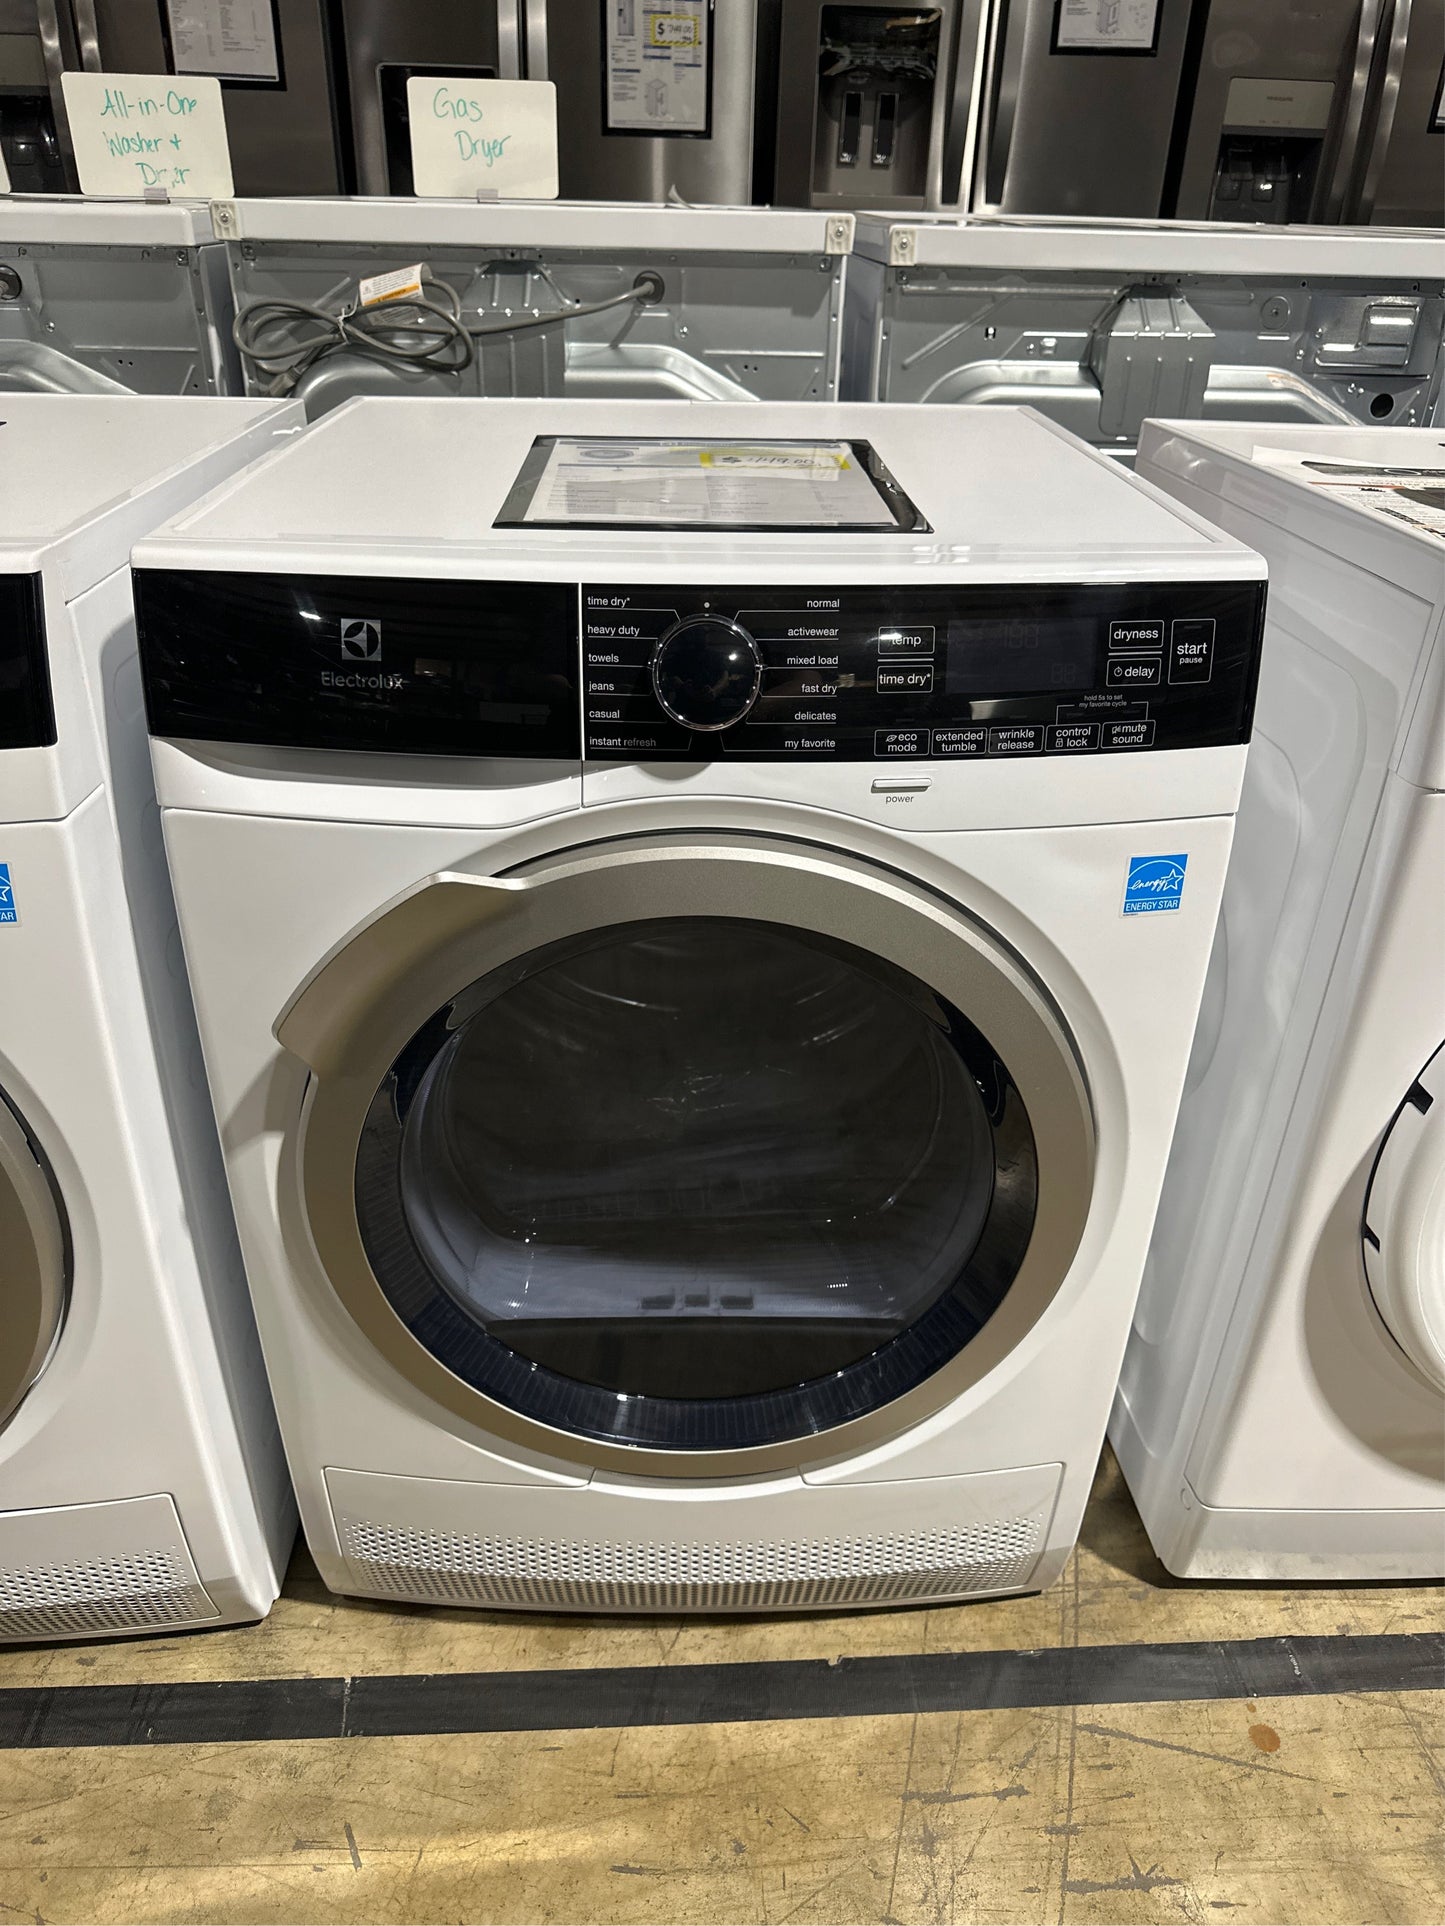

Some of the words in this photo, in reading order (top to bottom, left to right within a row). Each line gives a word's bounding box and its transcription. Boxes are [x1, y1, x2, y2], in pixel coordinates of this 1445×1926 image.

[100, 88, 198, 119] All-in-One
[433, 87, 483, 122] Gas
[102, 131, 163, 157] Washer
[455, 130, 512, 167] Dryer
[587, 596, 609, 606] time
[806, 598, 840, 608] normal
[587, 624, 617, 636] heavy
[618, 625, 641, 637] duty
[787, 627, 840, 637] activewear
[1113, 628, 1159, 642] dryness
[891, 634, 922, 648] temp
[1177, 642, 1208, 655] start
[588, 653, 620, 663] towels
[787, 655, 816, 665] mixed
[818, 655, 839, 665] load
[1179, 656, 1203, 665] pause
[1124, 666, 1155, 679] delay
[321, 671, 404, 690] Electrolux
[879, 673, 905, 685] time
[588, 681, 615, 692] jeans
[801, 683, 818, 694] fast
[821, 683, 838, 696] dry
[589, 709, 620, 719] casual
[794, 711, 837, 721] delicates
[998, 729, 1035, 740] wrinkle
[1055, 726, 1092, 737] control
[1121, 724, 1147, 734] mute
[589, 737, 621, 747] instant
[623, 738, 657, 747] refresh
[897, 732, 918, 741] eco
[935, 731, 984, 742] extended
[1066, 737, 1088, 747] lock
[1112, 733, 1144, 744] sound
[784, 740, 799, 750] my
[801, 738, 836, 748] favorite
[887, 742, 917, 752] mode
[941, 742, 977, 752] tumble
[997, 739, 1035, 750] release
[885, 794, 914, 804] power
[1125, 900, 1157, 912] ENERGY
[1157, 899, 1178, 910] STAR
